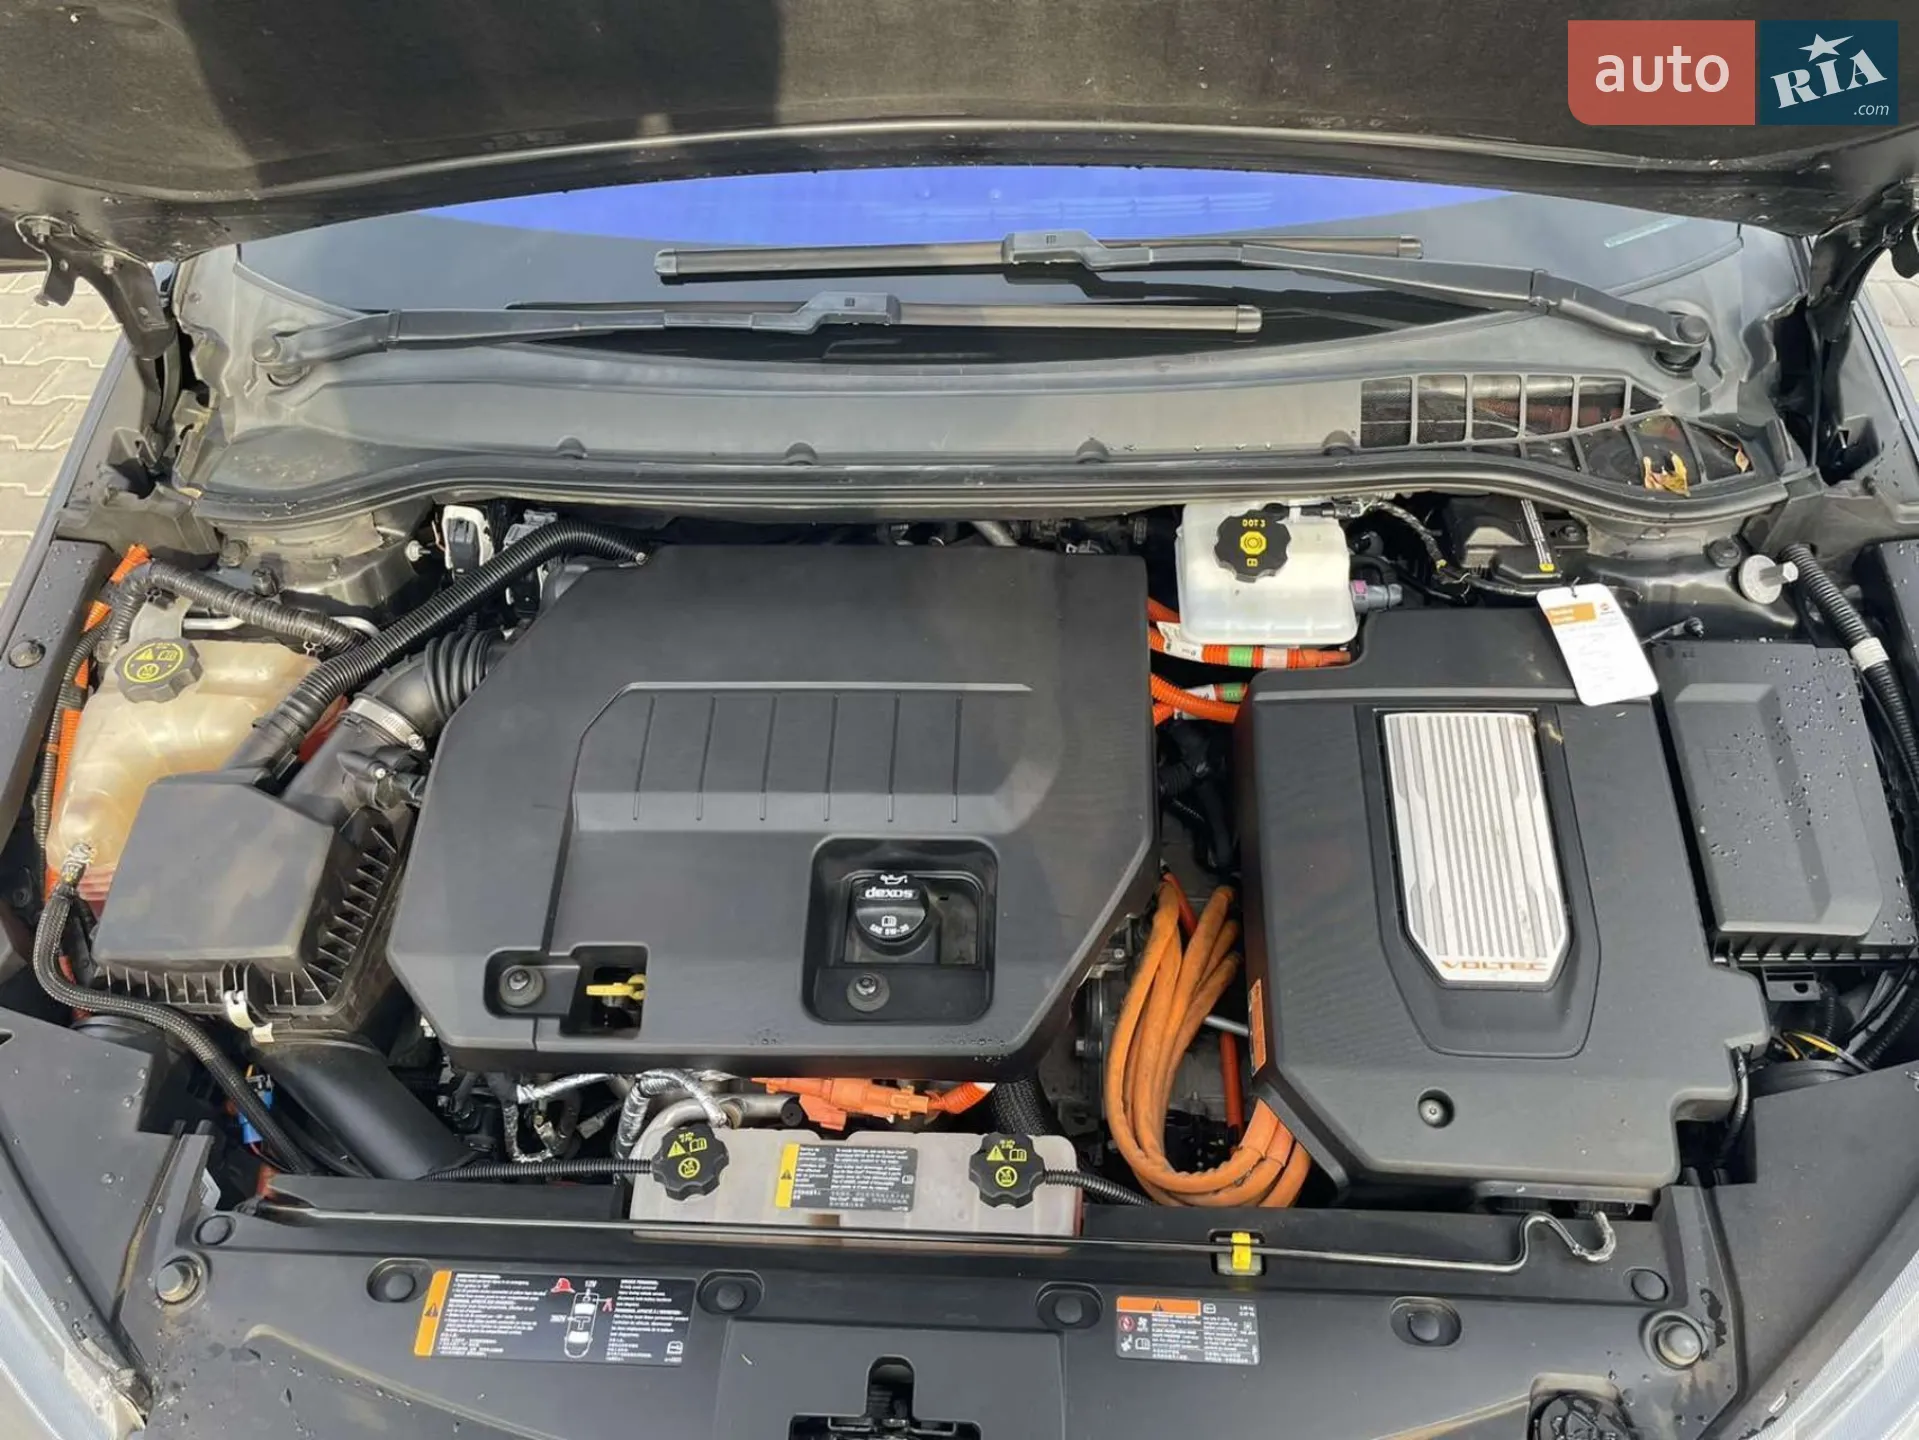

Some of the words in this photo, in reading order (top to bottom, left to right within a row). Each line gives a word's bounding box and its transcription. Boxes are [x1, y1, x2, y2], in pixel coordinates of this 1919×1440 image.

[1242, 519, 1259, 527] DOT
[1260, 519, 1266, 527] 3
[865, 886, 914, 899] dexos
[1441, 960, 1548, 971] VOLTEC
